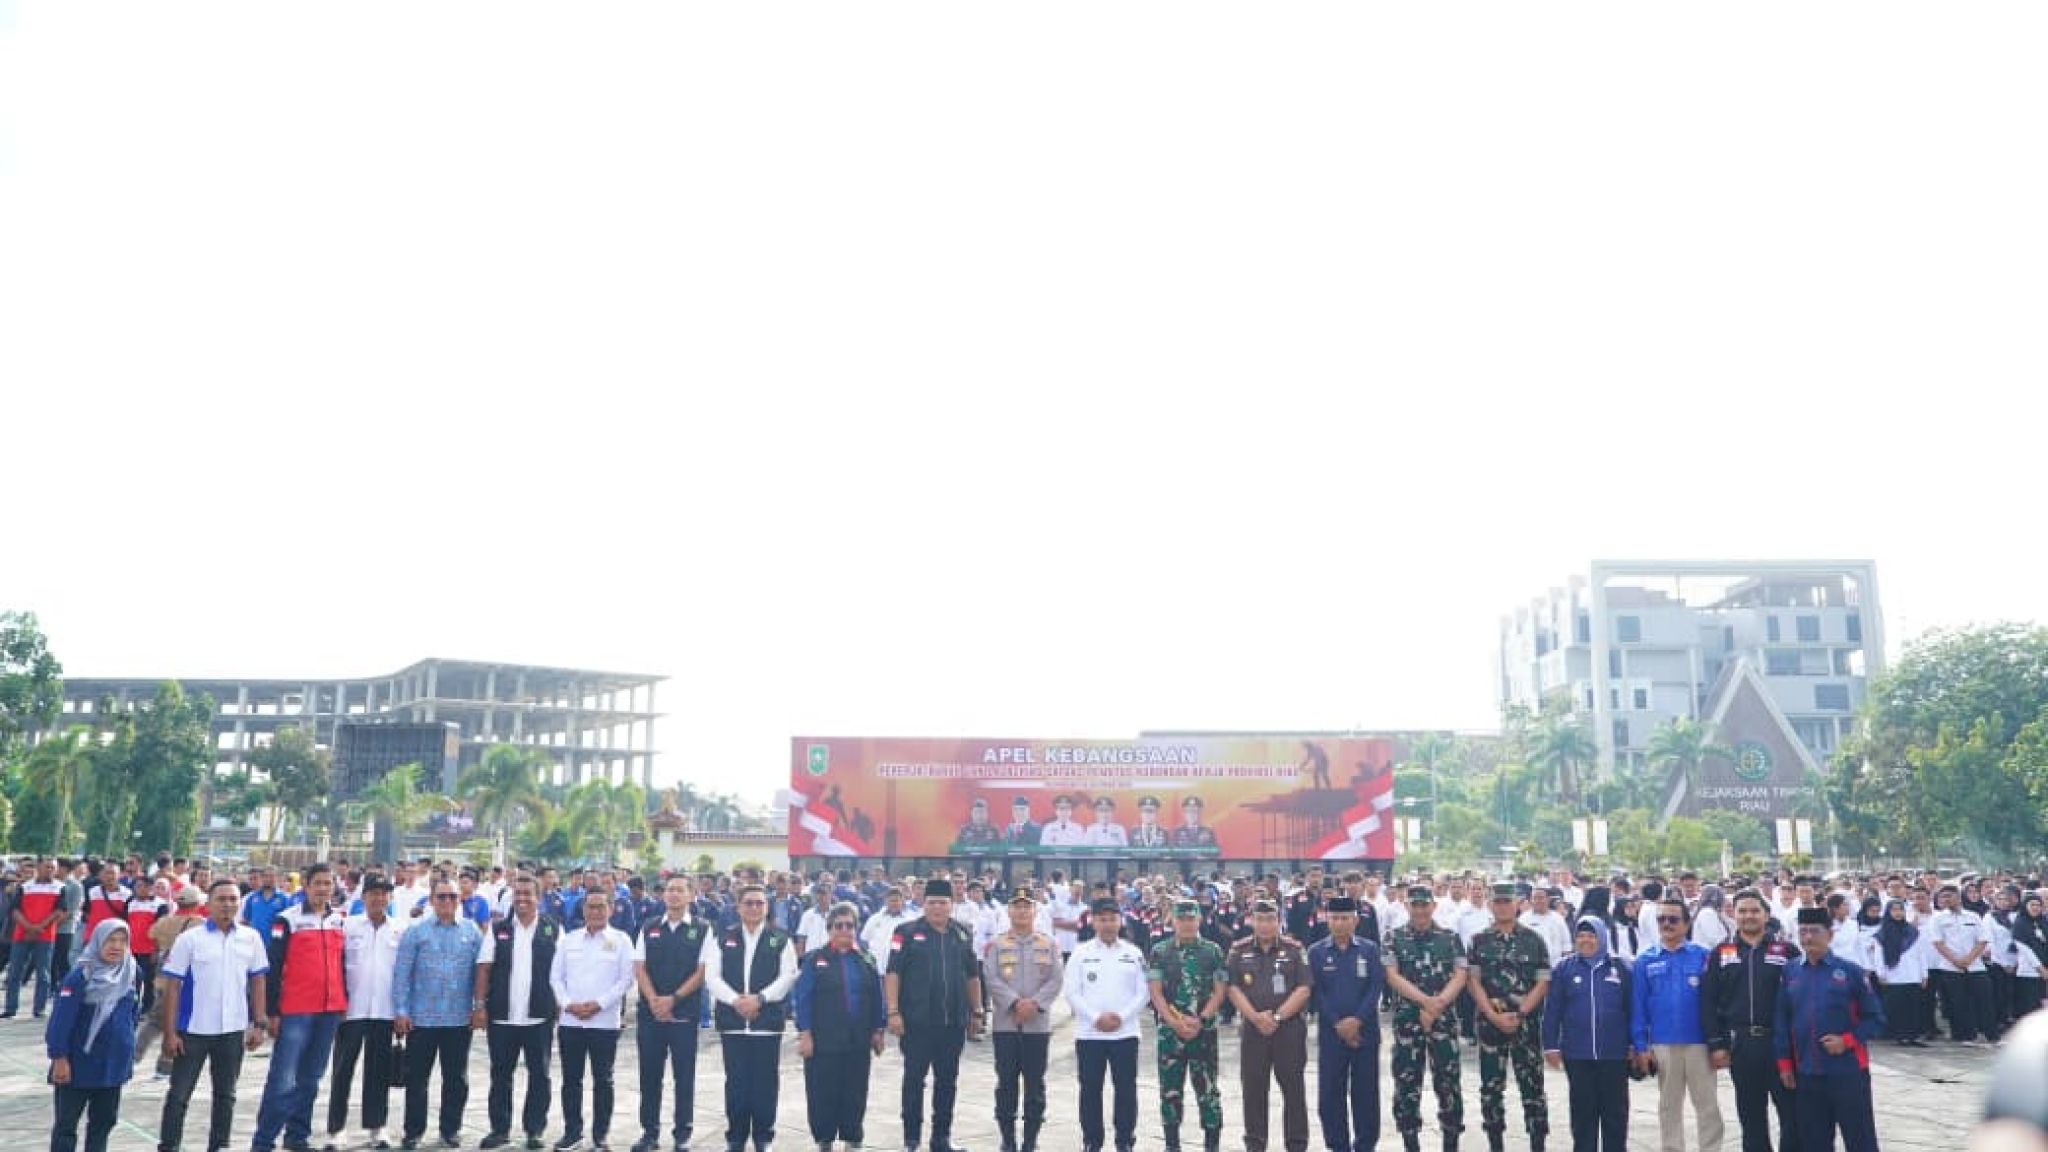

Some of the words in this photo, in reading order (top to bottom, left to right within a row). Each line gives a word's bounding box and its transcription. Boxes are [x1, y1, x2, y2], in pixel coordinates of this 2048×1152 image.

[983, 747, 1035, 763] APEL
[1045, 747, 1196, 763] KEBANGSAAN
[1739, 799, 1769, 812] RIAU
